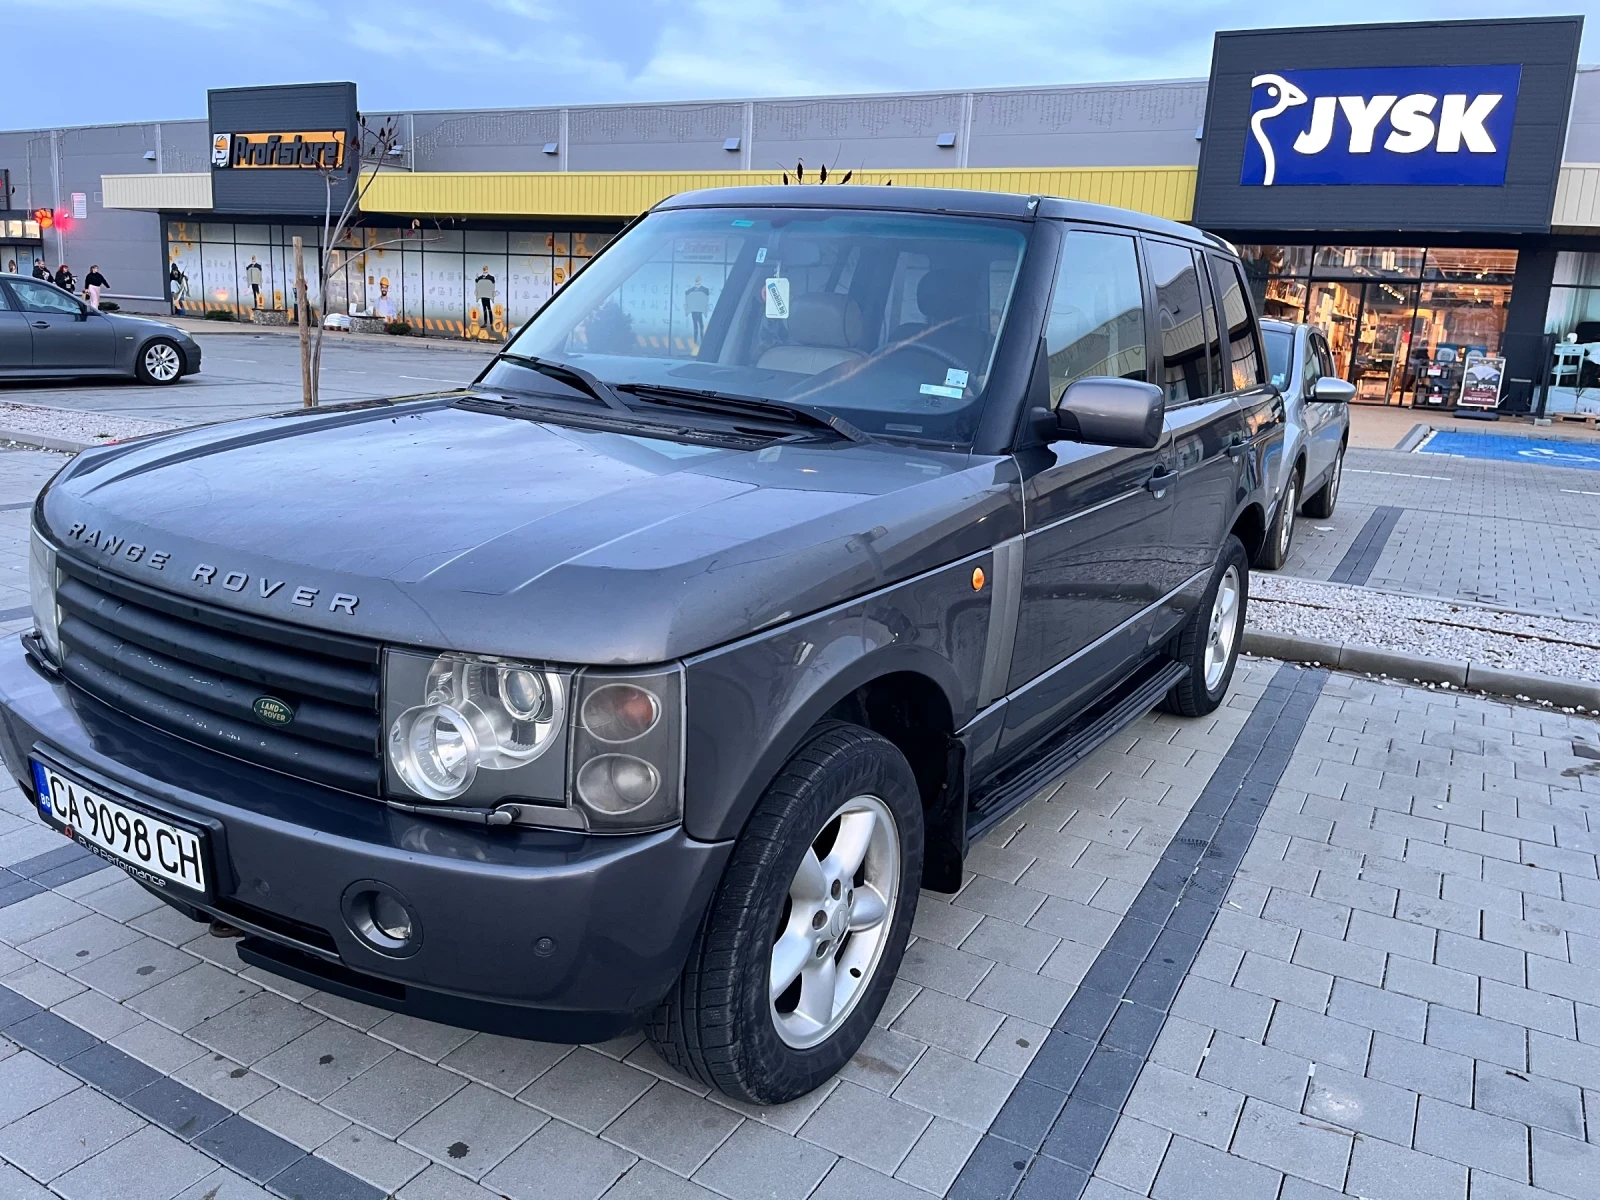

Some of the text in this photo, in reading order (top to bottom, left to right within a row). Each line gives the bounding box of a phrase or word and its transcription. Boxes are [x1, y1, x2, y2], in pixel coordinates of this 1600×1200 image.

[1293, 94, 1503, 153] JYSK
[68, 520, 360, 615] RANGE ROVER
[261, 701, 279, 713] LAND
[263, 709, 286, 721] ROVER
[40, 793, 51, 808] BG
[78, 835, 166, 887] Pure Performance
